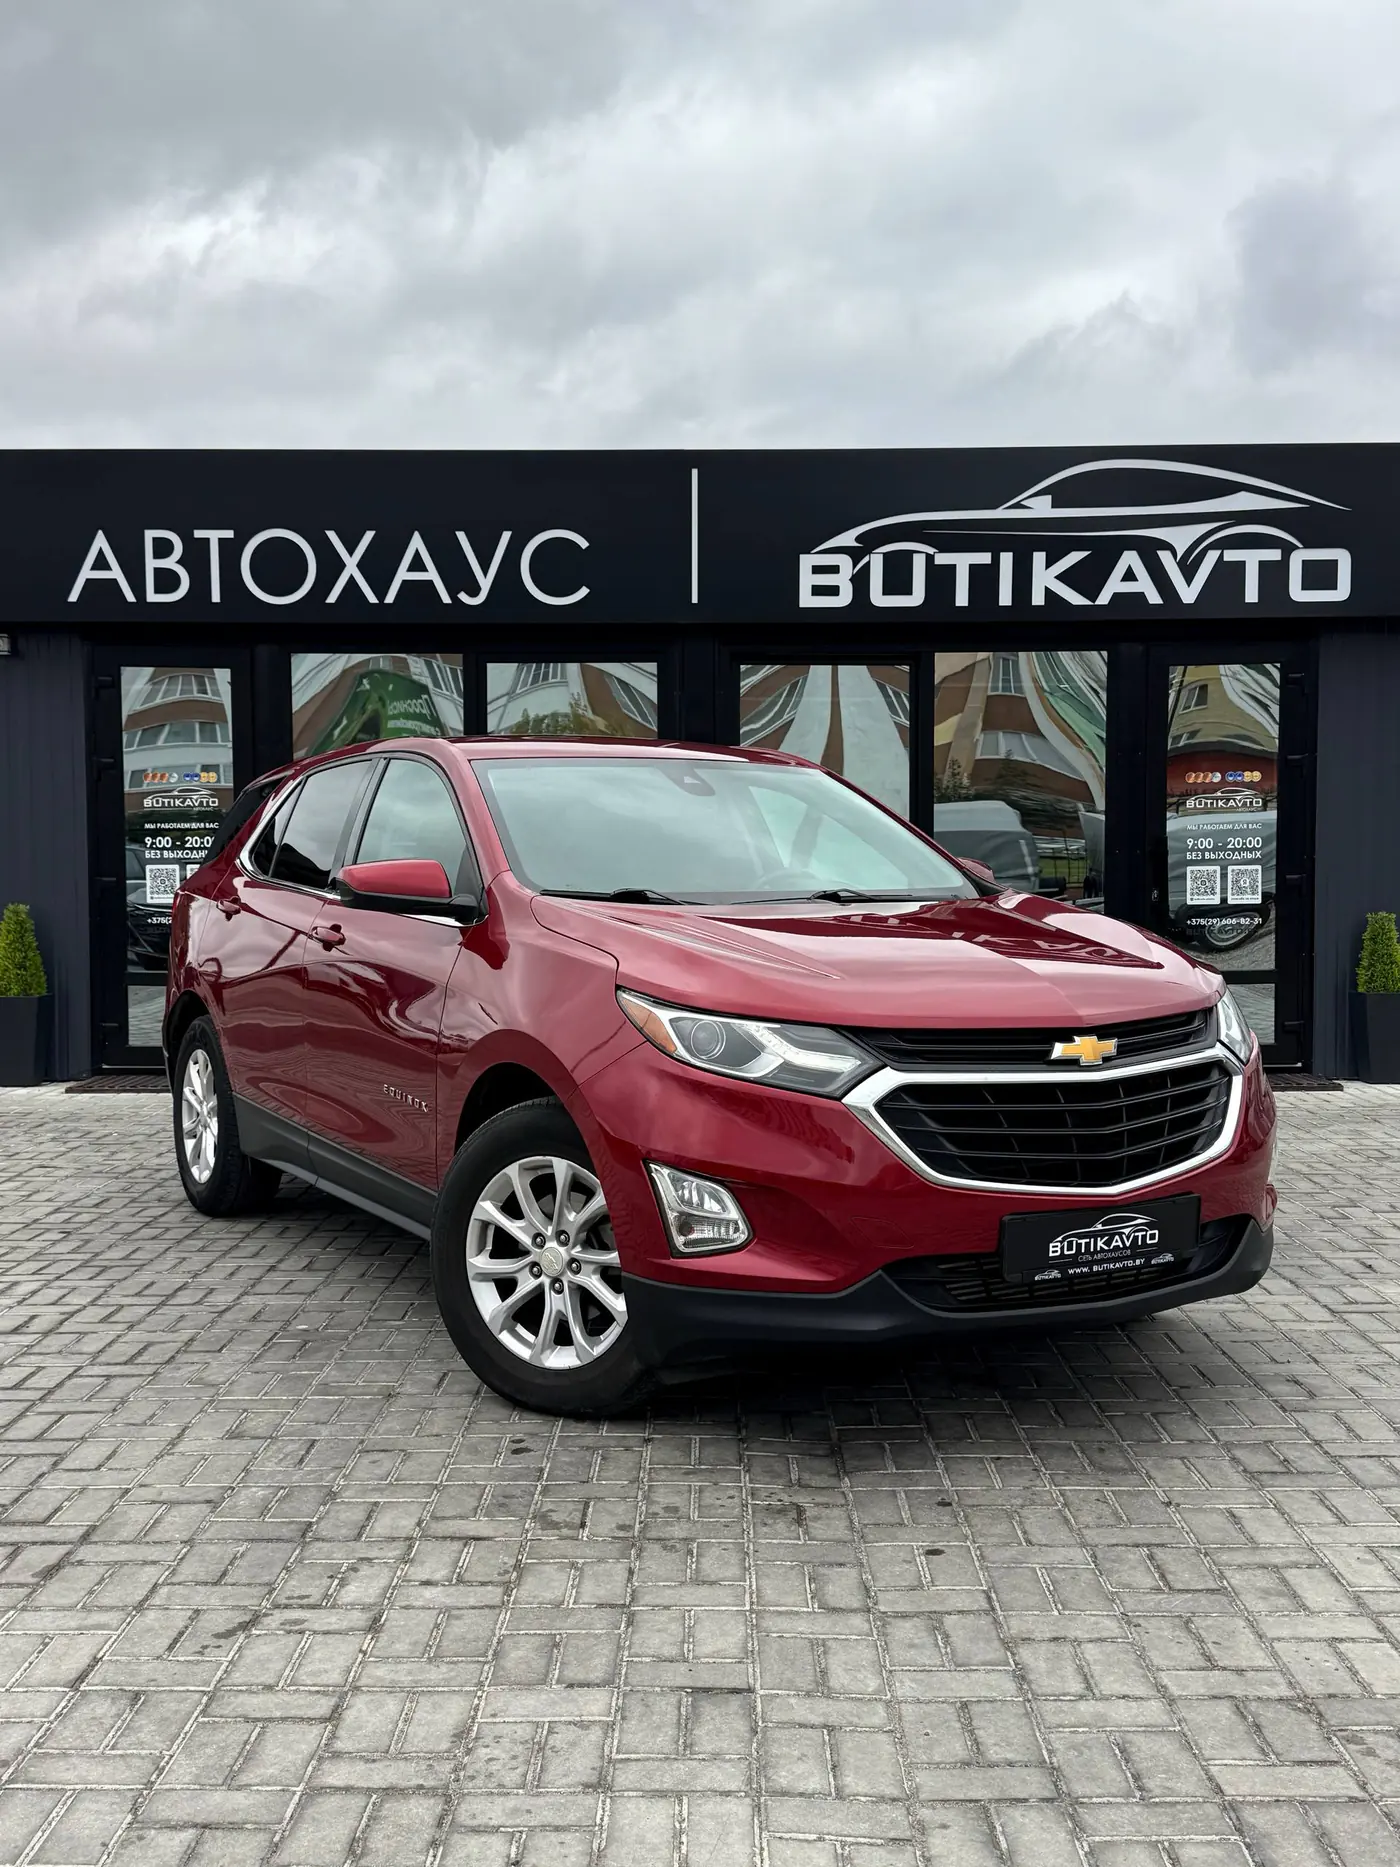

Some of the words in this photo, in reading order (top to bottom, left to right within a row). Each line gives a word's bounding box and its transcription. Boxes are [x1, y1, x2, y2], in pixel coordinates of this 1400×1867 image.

[67, 528, 590, 606] АВТОХАУС
[798, 548, 1352, 608] BUTIKAVTO
[143, 798, 219, 808] BUTIKAVTO
[1186, 798, 1263, 808] BUTIKAVTO
[144, 836, 172, 848] 9:00
[1186, 837, 1213, 849] 9:00
[1226, 836, 1262, 849] 20:00
[145, 850, 161, 859] БЕЗ
[163, 849, 208, 859] ВЫХОДН
[1186, 851, 1202, 860] БЕЗ
[1204, 850, 1262, 860] ВЫХОДНЫХ
[147, 917, 172, 925] +375(2
[383, 1083, 429, 1113] EQUINOX
[1048, 1229, 1159, 1257] BUTIKAVTO
[1077, 1255, 1093, 1263] СЕТЬ
[1093, 1249, 1132, 1260] АВТОХАУСОВ
